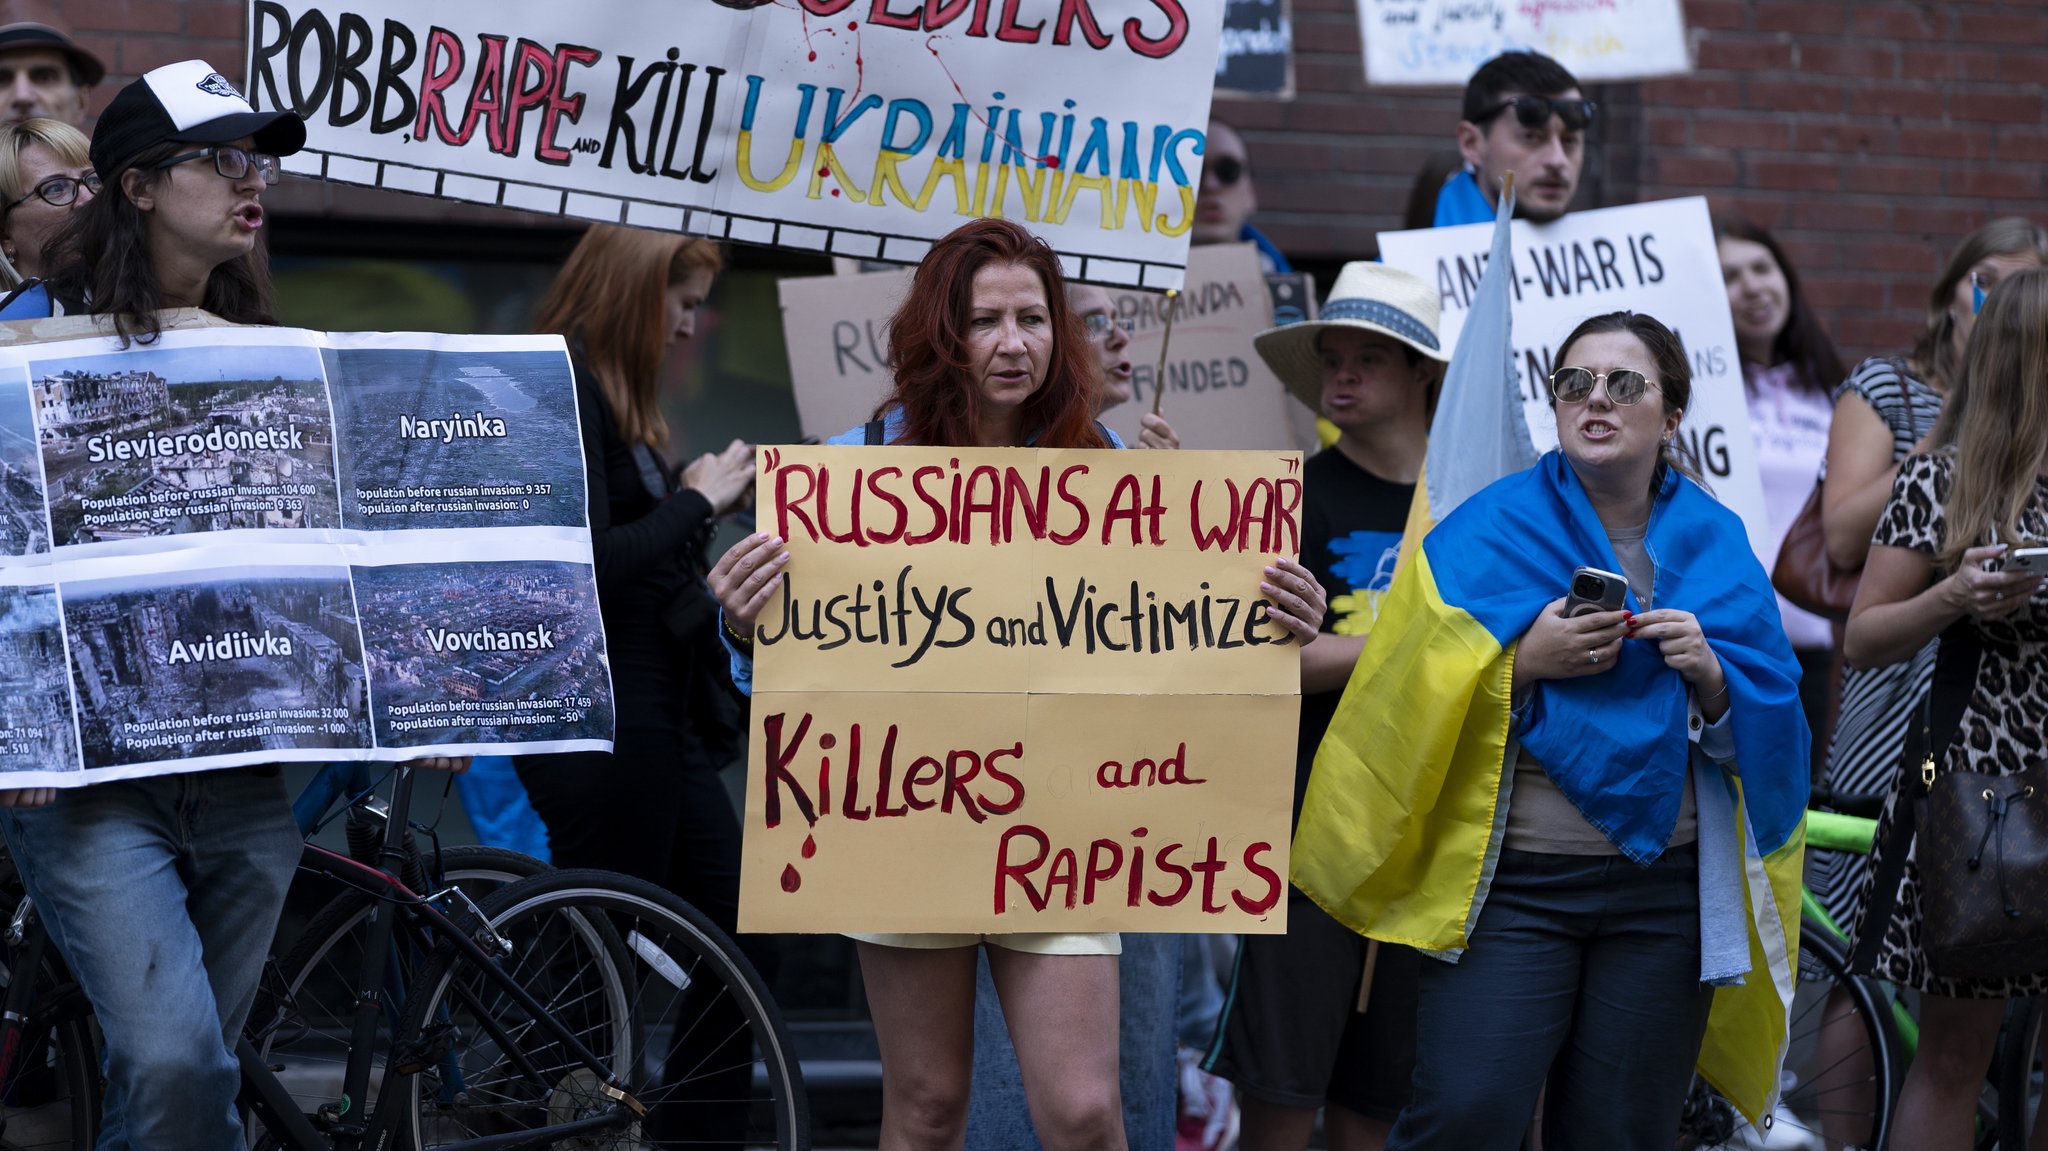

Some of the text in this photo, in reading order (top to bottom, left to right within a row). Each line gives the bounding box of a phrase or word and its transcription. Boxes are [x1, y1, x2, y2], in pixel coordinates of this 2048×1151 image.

[413, 26, 602, 166] RAPE
[571, 137, 601, 155] AND
[1438, 234, 1664, 311] ANI-WAR IS
[400, 412, 507, 443] Maryinka
[88, 424, 303, 462] Sievierodonetsk
[81, 484, 316, 511] Population before russian invasion: 104 600
[406, 485, 441, 498] before
[443, 486, 478, 497] russian
[480, 484, 525, 496] invasion:
[525, 484, 532, 494] 9
[534, 484, 551, 495] 357
[83, 499, 302, 526] Population after russian invasion: 9 363
[409, 500, 436, 512] after
[437, 500, 473, 512] russian
[475, 499, 519, 511] invasion:
[522, 499, 529, 510] 0
[757, 565, 1296, 668] Justifys and Victimize
[168, 630, 292, 664] Avidiivka
[426, 624, 554, 652] Vovchansk
[388, 698, 592, 717] Population before russian invasion: 17 459
[15, 728, 27, 740] 71
[124, 707, 349, 736] Population before russian invasion: 32 000
[390, 711, 579, 732] Population after russian invasion: ~50
[12, 743, 29, 755] 518
[126, 723, 345, 749] Population after russian invasion: ~1 000
[1097, 742, 1207, 790] and
